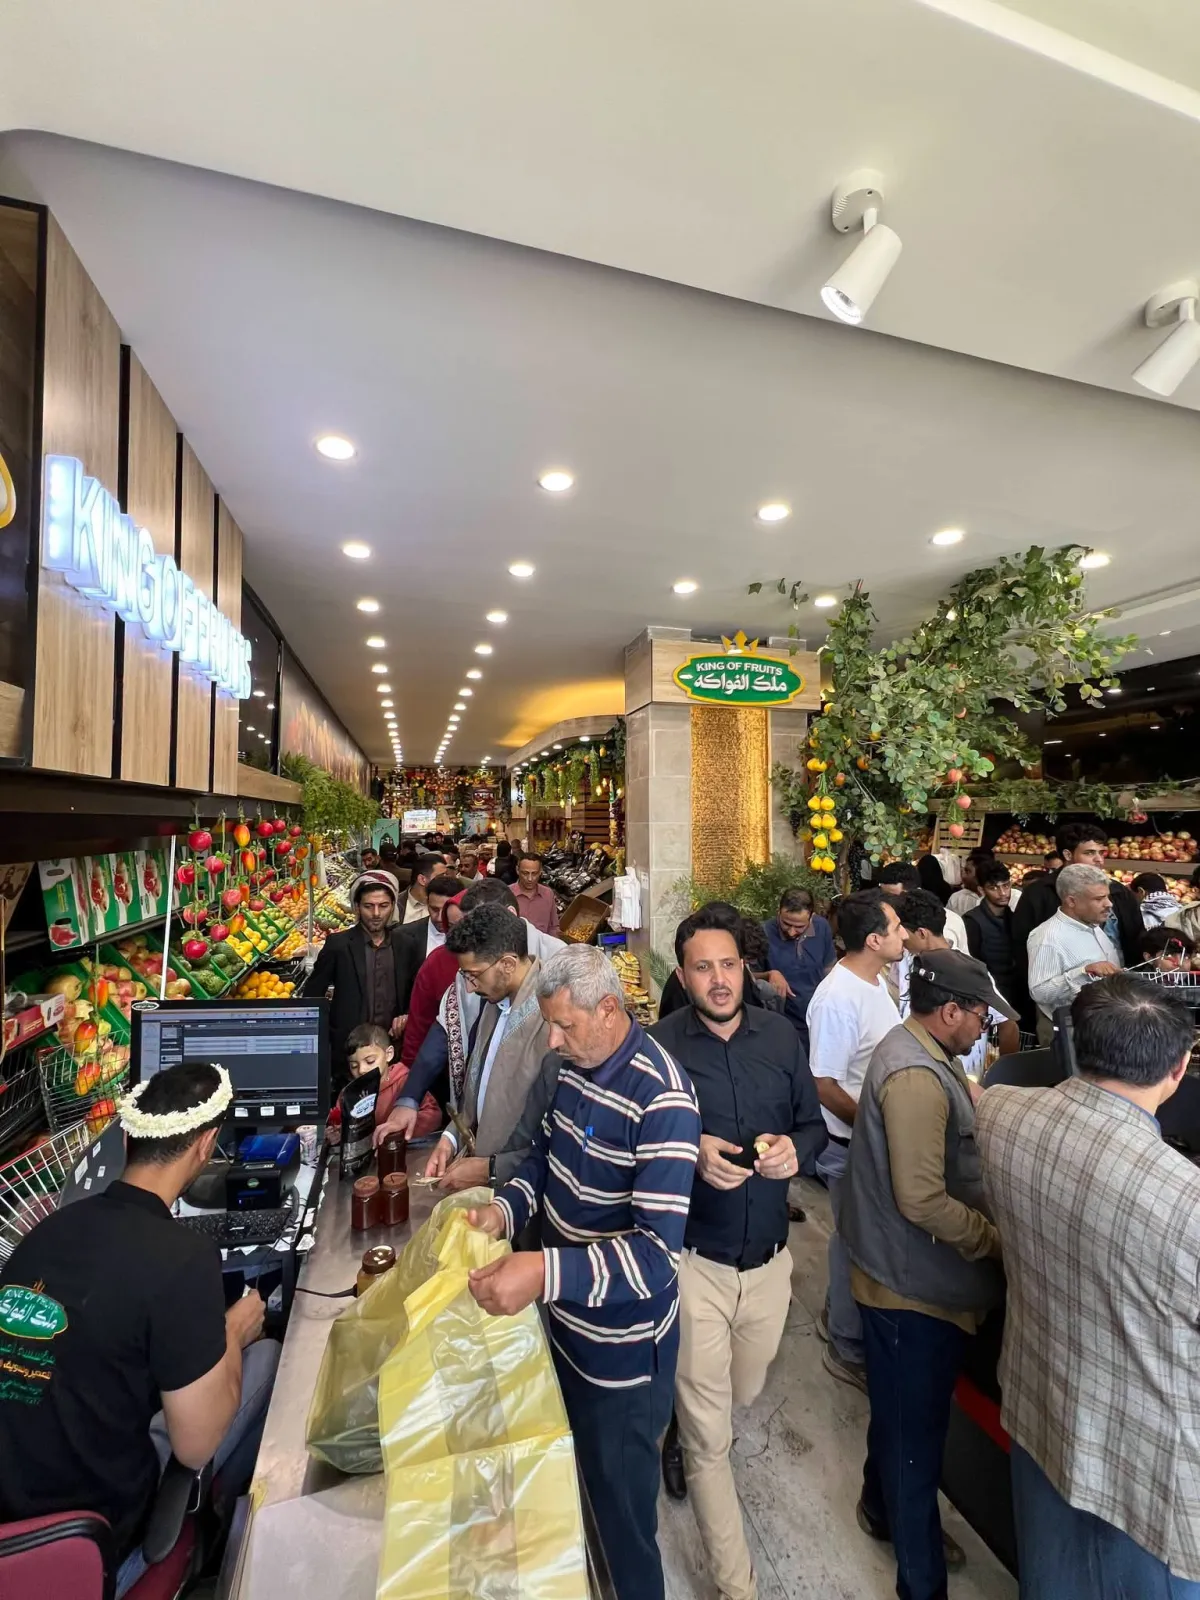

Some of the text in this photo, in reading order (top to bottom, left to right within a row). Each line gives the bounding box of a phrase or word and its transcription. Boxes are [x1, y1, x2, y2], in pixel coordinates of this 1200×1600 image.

[42, 454, 156, 623] KING
[180, 589, 252, 700] FRUITS
[696, 661, 783, 677] KING OF FRUITS
[694, 672, 788, 695] ملك الفواكه
[5, 1288, 25, 1299] KING
[30, 1309, 58, 1330] ملك
